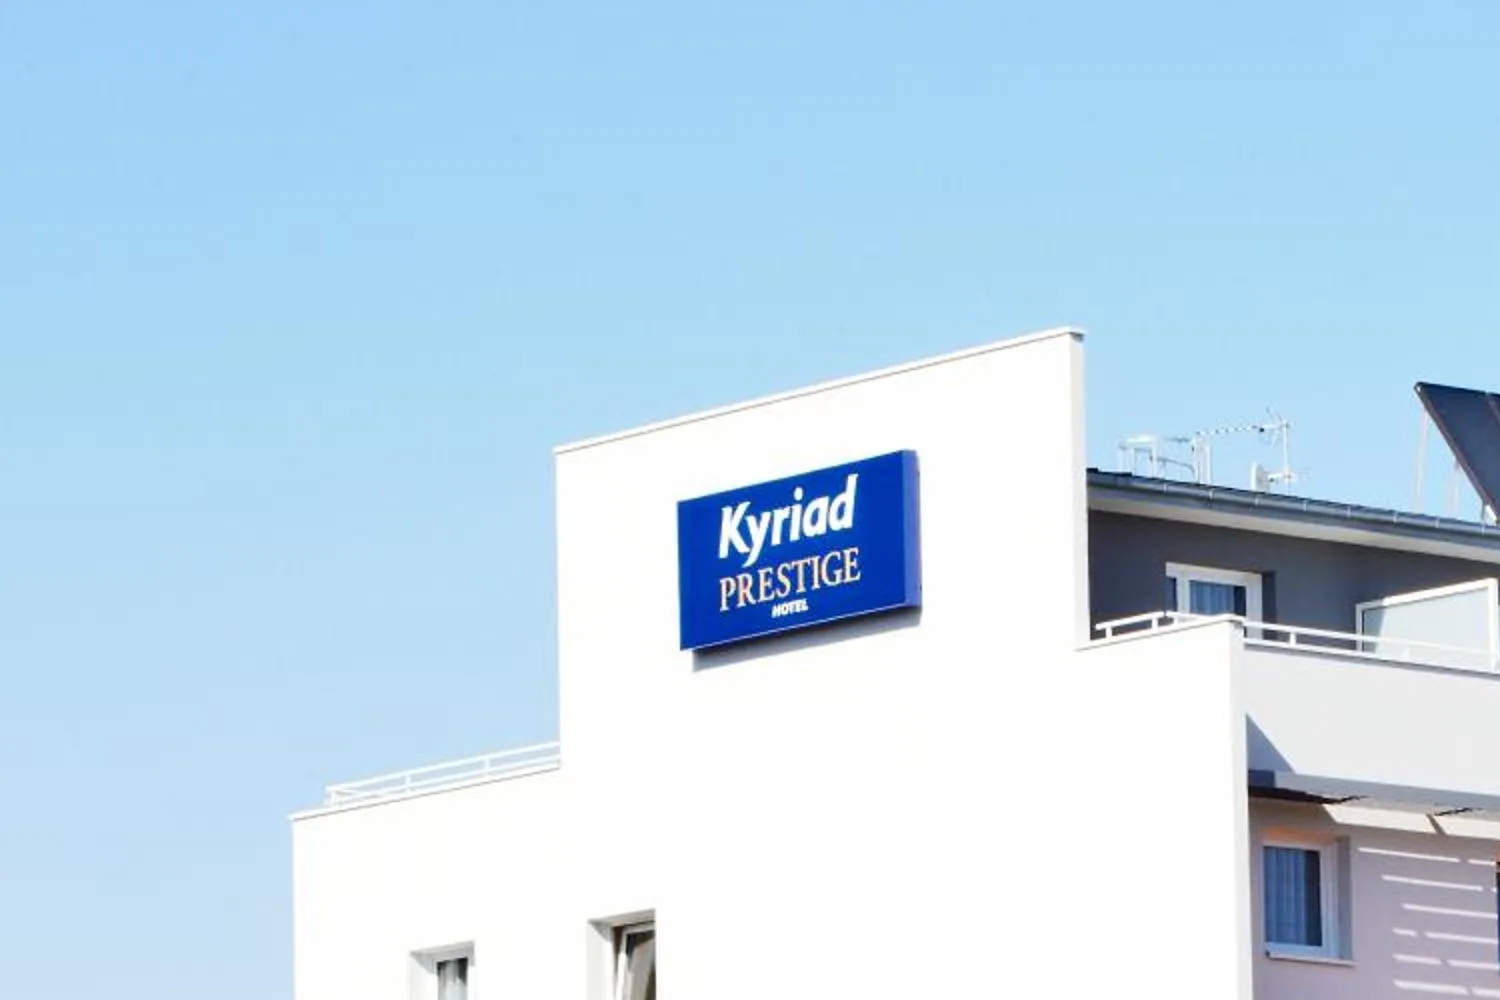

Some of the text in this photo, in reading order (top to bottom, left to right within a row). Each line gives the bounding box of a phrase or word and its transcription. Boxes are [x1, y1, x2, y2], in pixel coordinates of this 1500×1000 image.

[718, 473, 859, 568] Kyriad
[719, 547, 861, 612] PRESTIGE
[771, 598, 809, 618] HOTEL
